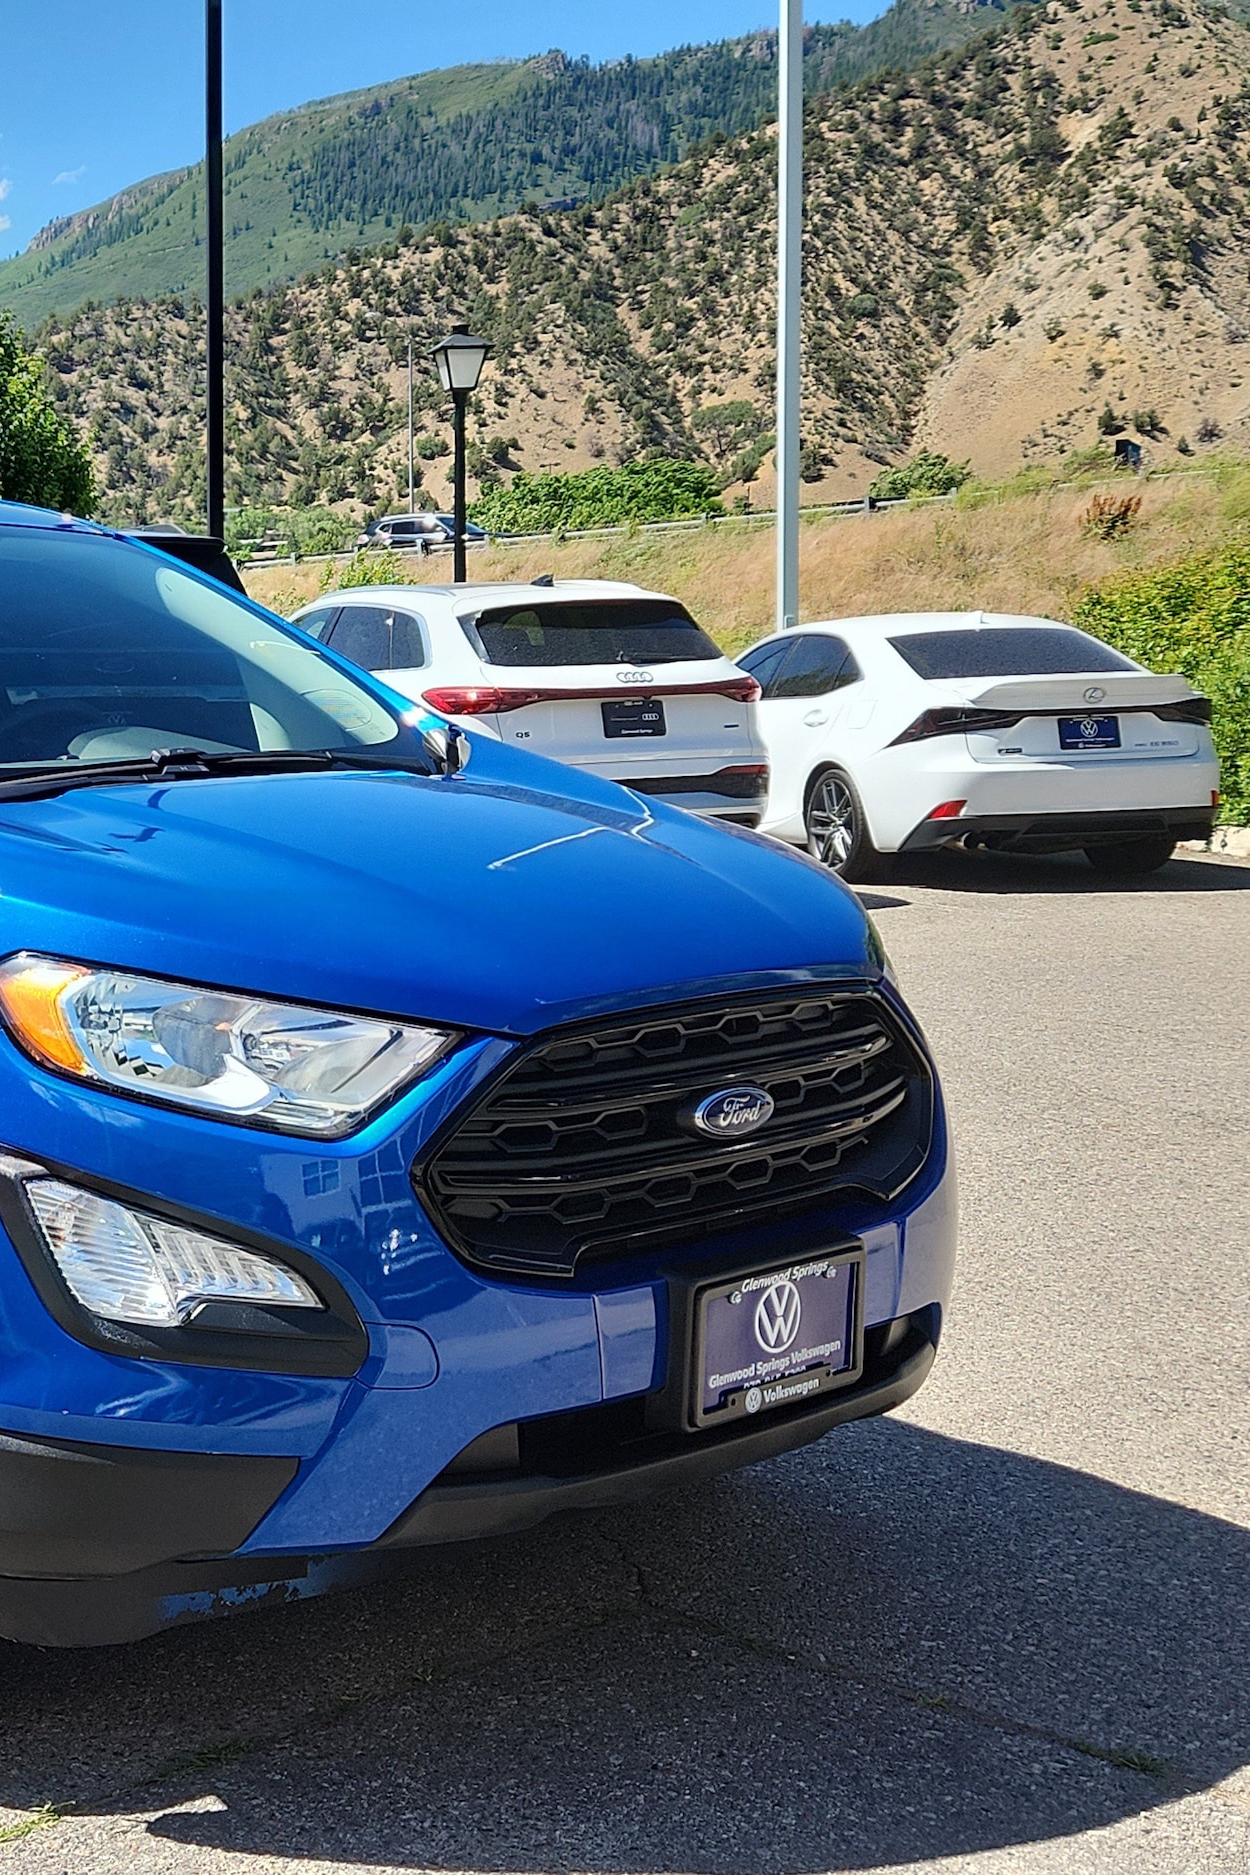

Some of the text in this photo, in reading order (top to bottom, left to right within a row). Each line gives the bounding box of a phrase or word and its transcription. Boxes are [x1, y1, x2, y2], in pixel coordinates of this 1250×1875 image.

[515, 731, 531, 739] Q5
[718, 1096, 763, 1127] Ford
[741, 1261, 830, 1294] Glenwood Springs
[708, 1362, 756, 1389] Glenwood
[756, 1354, 791, 1377] Springs
[791, 1339, 842, 1365] Volkswagen
[763, 1376, 821, 1404] Volkswagen
